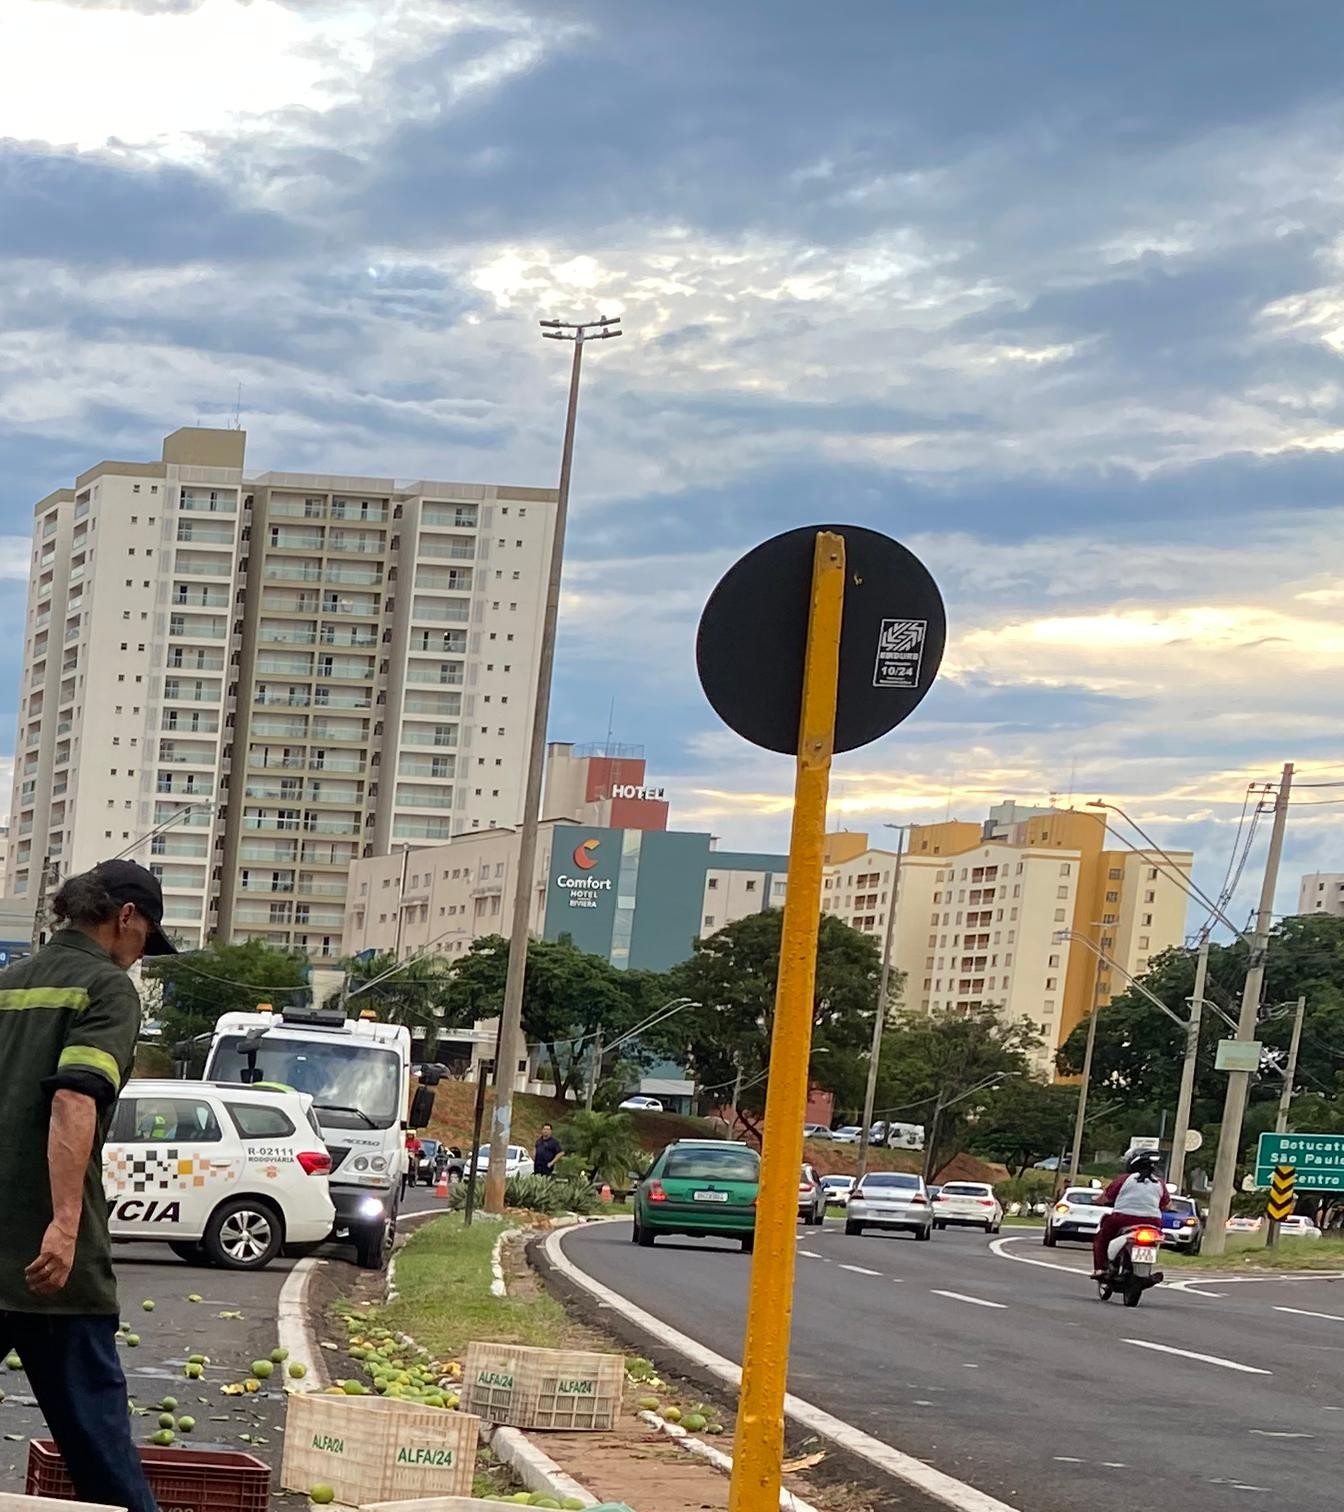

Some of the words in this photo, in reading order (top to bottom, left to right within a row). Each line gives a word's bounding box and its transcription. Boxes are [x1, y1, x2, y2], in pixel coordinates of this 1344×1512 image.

[881, 666, 913, 676] 10/24
[612, 784, 665, 800] HOTEL
[557, 875, 612, 890] Comfort
[570, 890, 598, 898] HOTEL
[248, 1147, 294, 1156] R-02111
[1280, 1139, 1344, 1151] Botucat
[1270, 1153, 1297, 1163] São
[1294, 1173, 1340, 1185] entro
[478, 1371, 512, 1388] ALFA/24
[558, 1380, 592, 1395] ALFA/24
[313, 1434, 344, 1454] ALFA/24
[398, 1448, 452, 1466] ALFA/24
